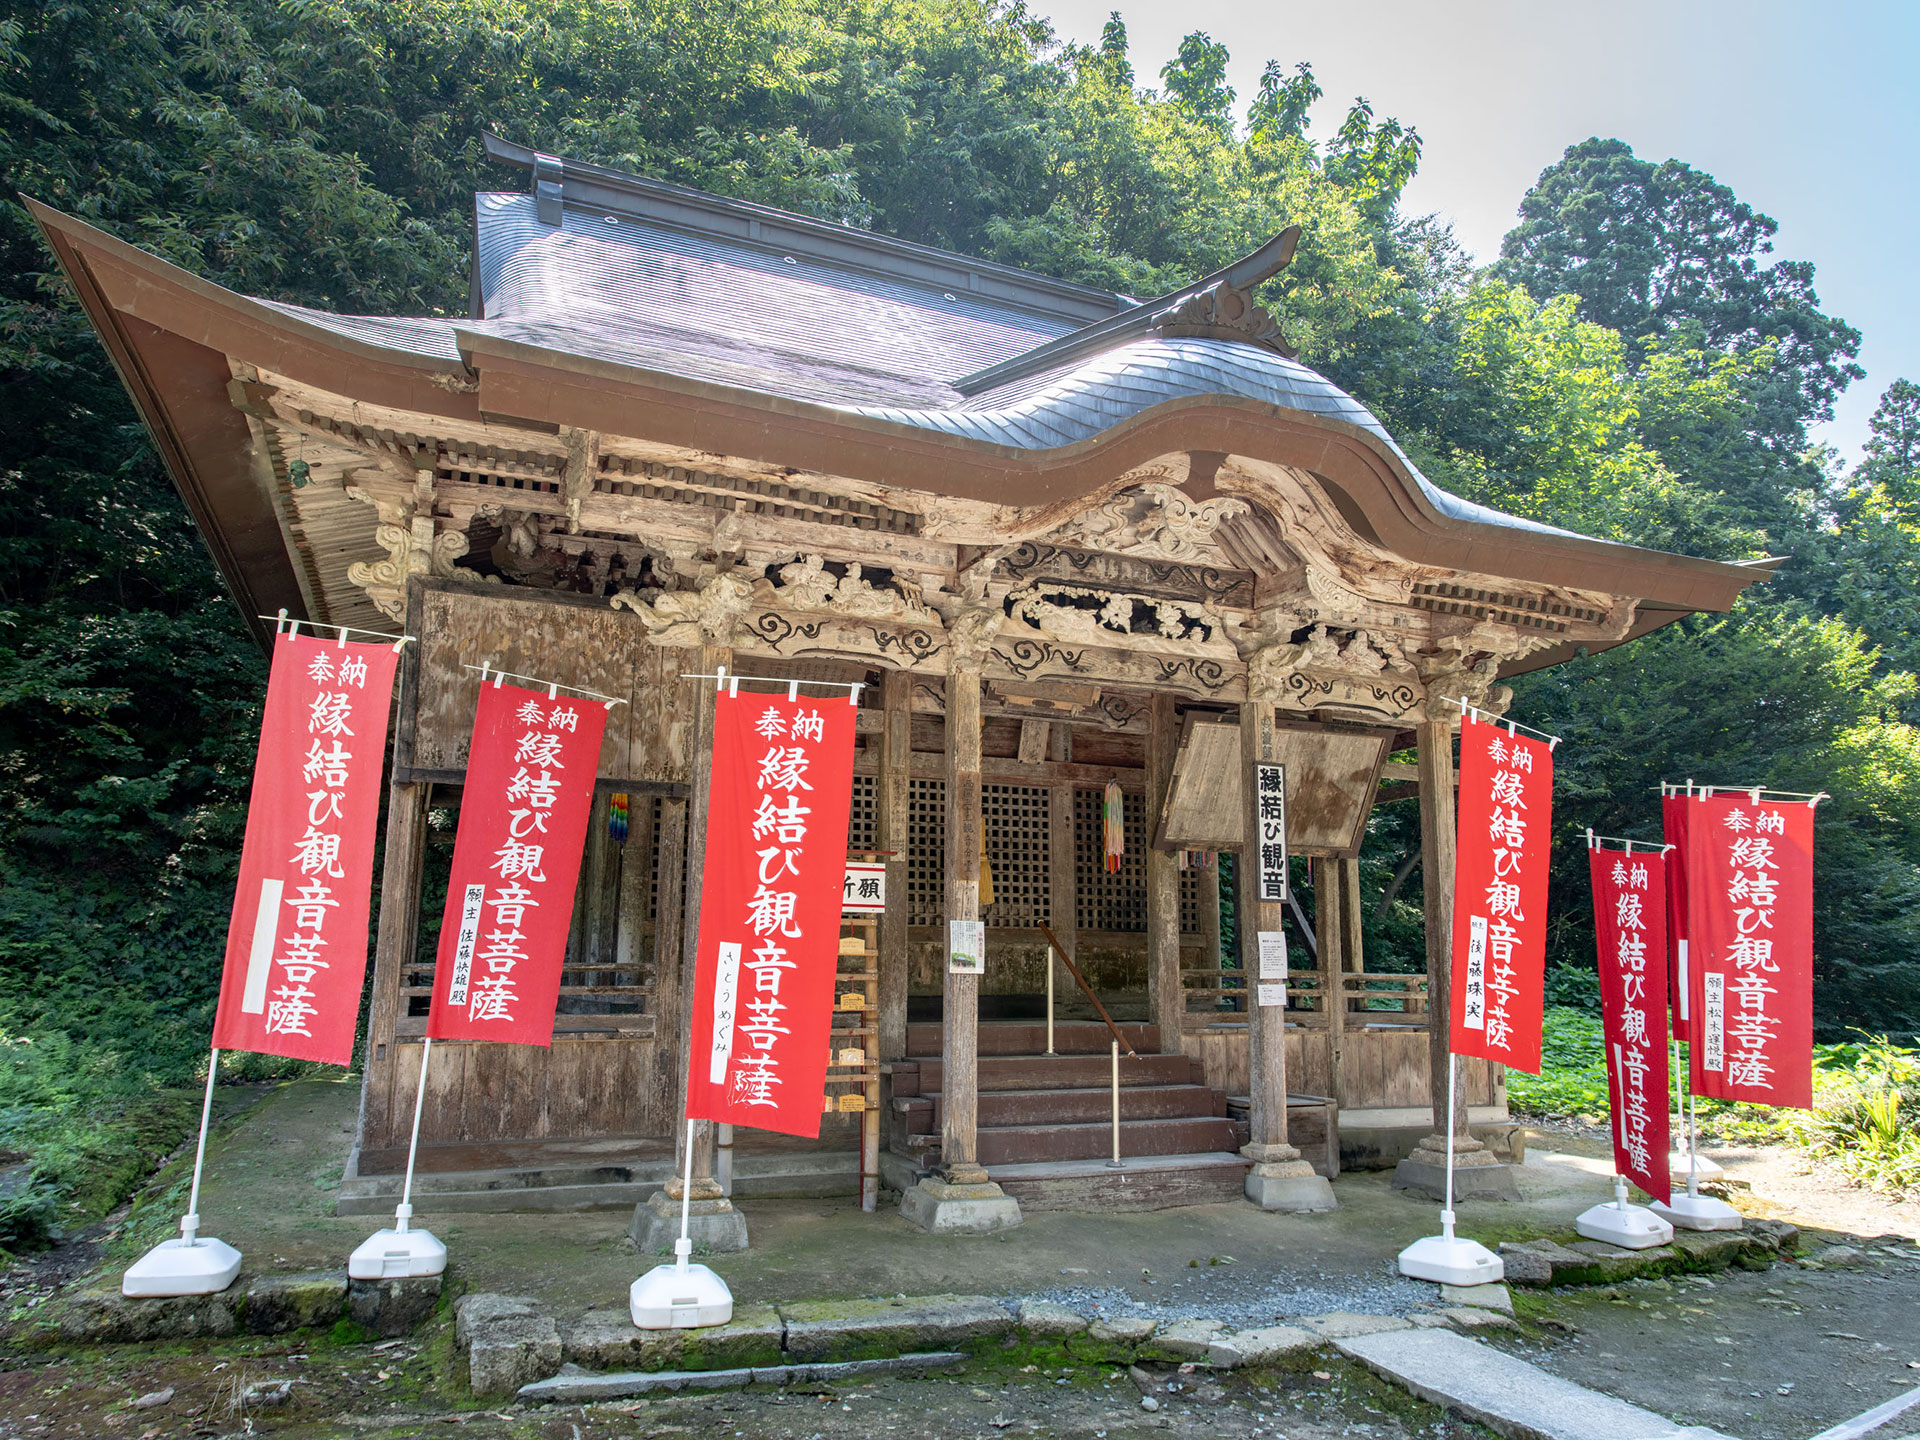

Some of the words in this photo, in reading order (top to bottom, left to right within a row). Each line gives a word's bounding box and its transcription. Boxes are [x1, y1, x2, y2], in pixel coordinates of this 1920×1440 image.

[307, 651, 368, 690] 奉納
[515, 700, 579, 733] 奉納
[754, 705, 825, 744] 奉納
[1487, 736, 1534, 774] 奉納
[265, 691, 356, 1038] 縁結び観音菩薩
[1259, 768, 1284, 898] 縁結び観音
[1723, 807, 1786, 836] 奉納
[466, 888, 482, 920] 願主
[468, 731, 565, 1023] 縁結び観音菩薩
[1484, 770, 1528, 1052] 縁結び観音菩薩
[1611, 859, 1648, 892] 奉納
[728, 746, 814, 1109] 縁結び観音菩薩
[1724, 836, 1781, 1090] 縁結び観音菩薩
[714, 951, 734, 1053] さとうめぐみ
[1615, 892, 1652, 1178] 縁結び観音菩薩
